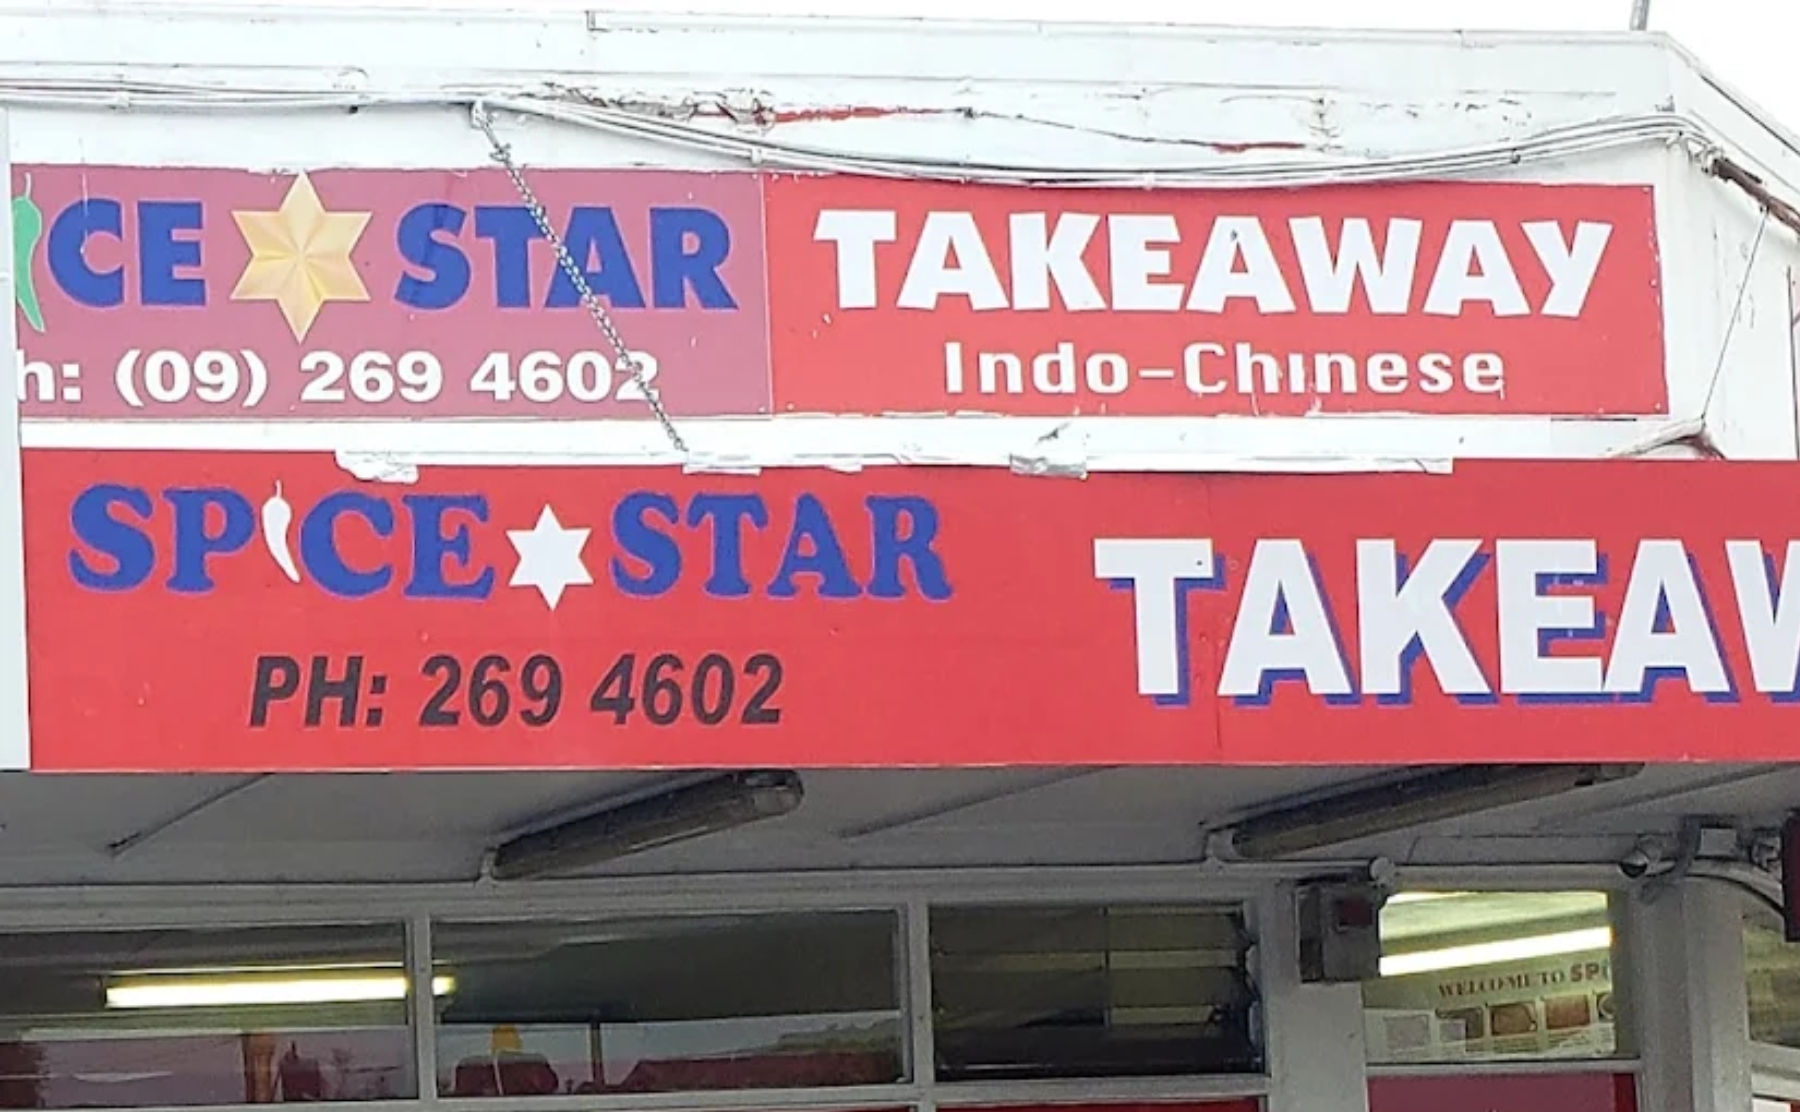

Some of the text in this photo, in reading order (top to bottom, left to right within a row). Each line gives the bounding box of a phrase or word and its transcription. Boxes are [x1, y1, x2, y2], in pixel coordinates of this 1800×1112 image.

[395, 202, 738, 310] STAR
[813, 208, 1614, 317] TAKEAWAY
[114, 349, 268, 407] (09)
[298, 351, 442, 403] 269
[470, 351, 661, 403] 4602
[944, 341, 1506, 396] Indo-Chinese
[610, 492, 954, 602] STAR
[249, 654, 785, 728] PH: 269 4602
[1537, 969, 1565, 985] TO
